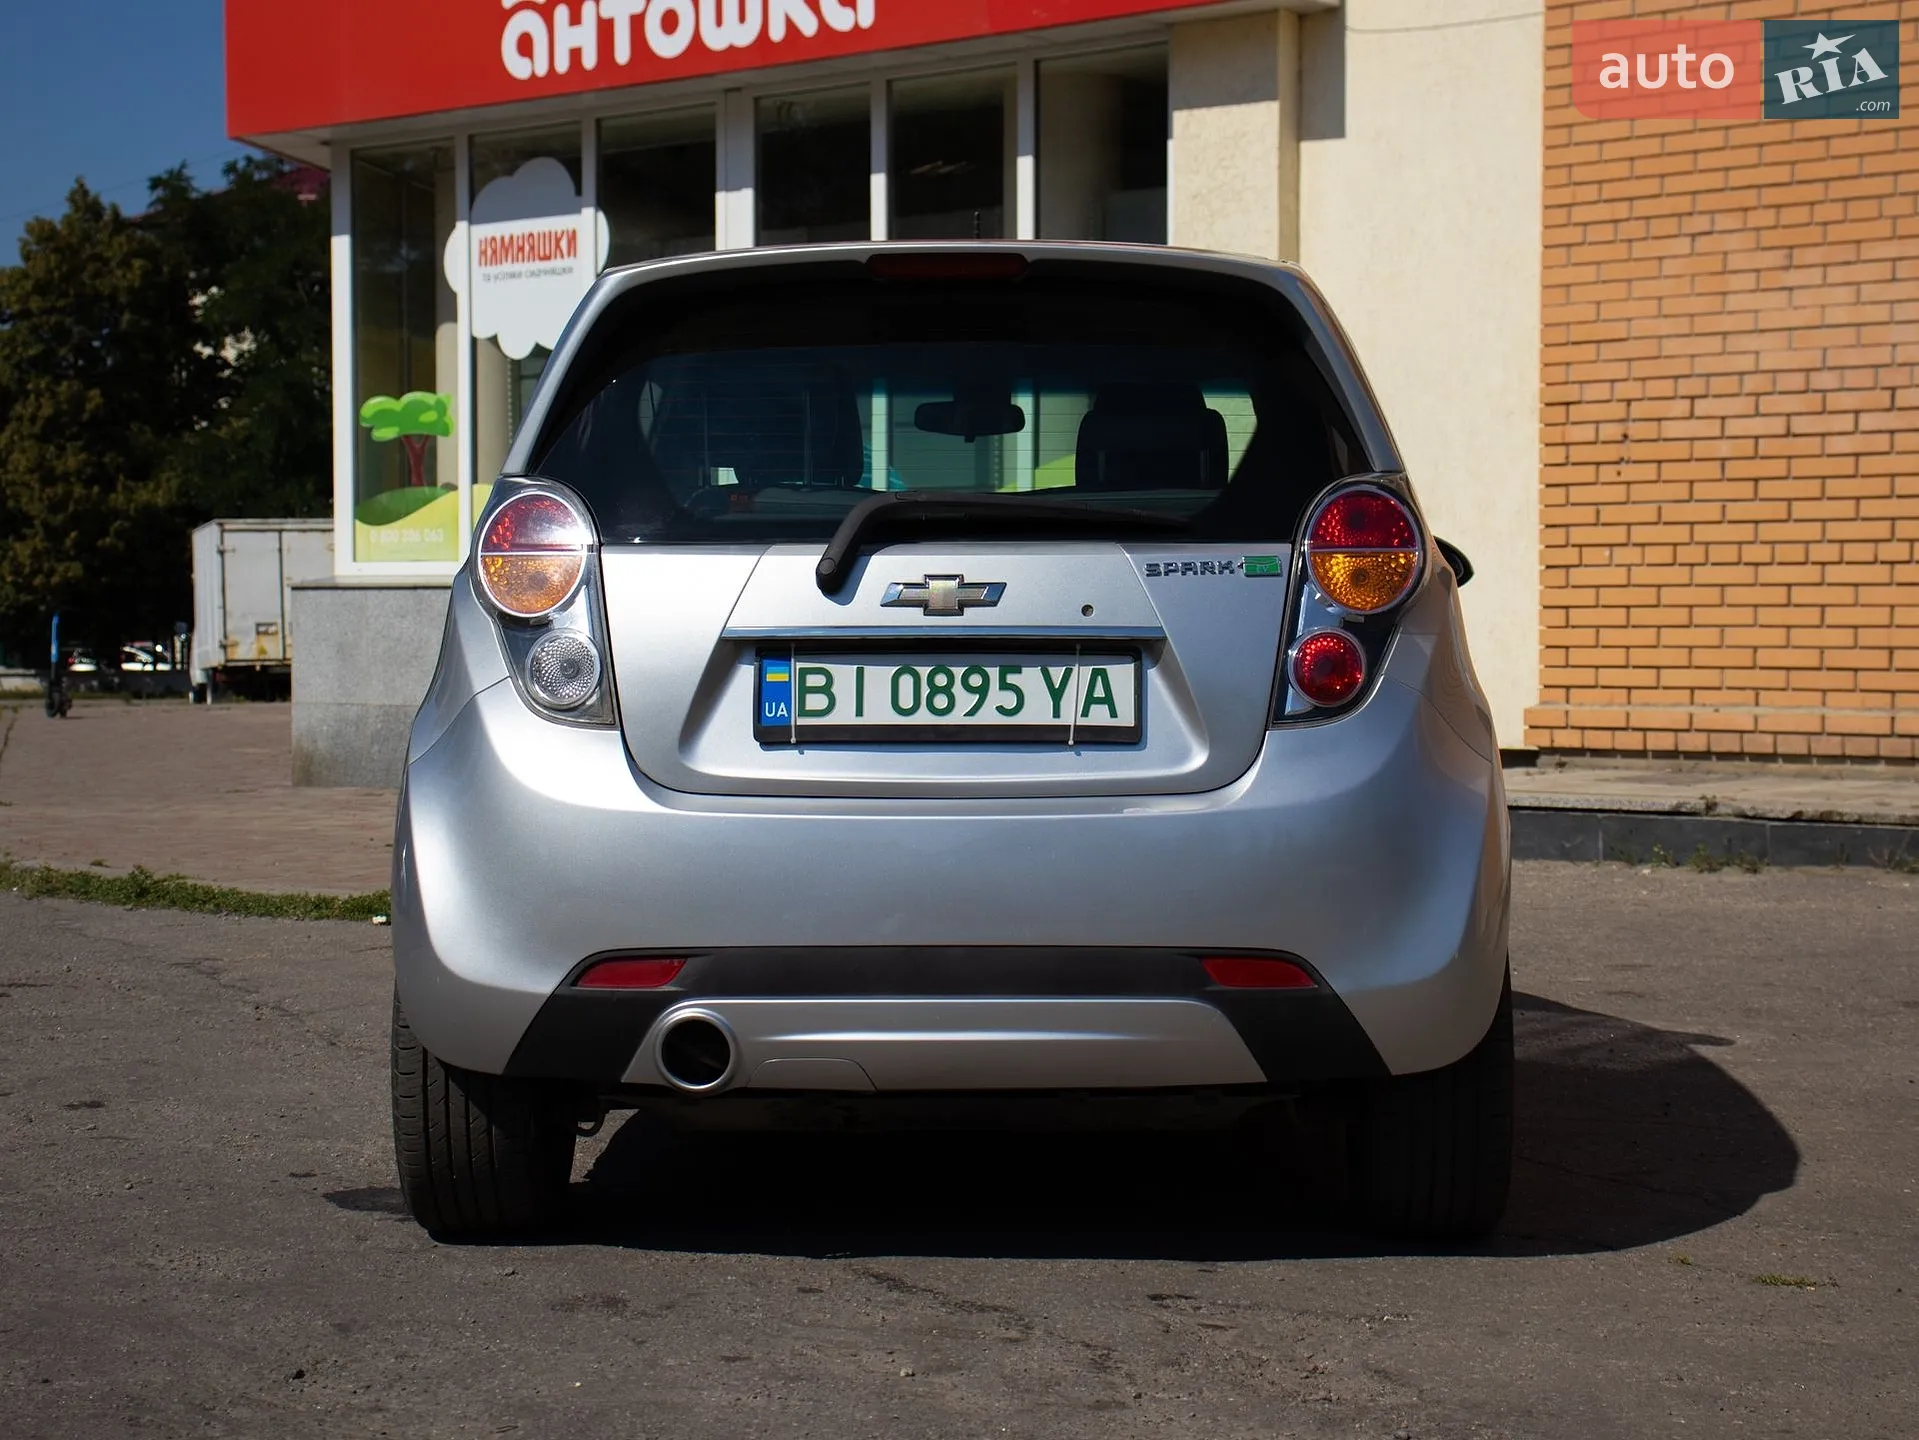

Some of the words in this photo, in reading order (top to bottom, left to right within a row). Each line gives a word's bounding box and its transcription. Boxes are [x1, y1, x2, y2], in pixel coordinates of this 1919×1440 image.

[479, 228, 577, 267] НЯМНЯШКИ
[1145, 560, 1235, 577] SPARK
[798, 666, 865, 718] BI
[890, 664, 1025, 718] 0895
[1040, 666, 1119, 719] YA
[765, 702, 788, 718] UA
